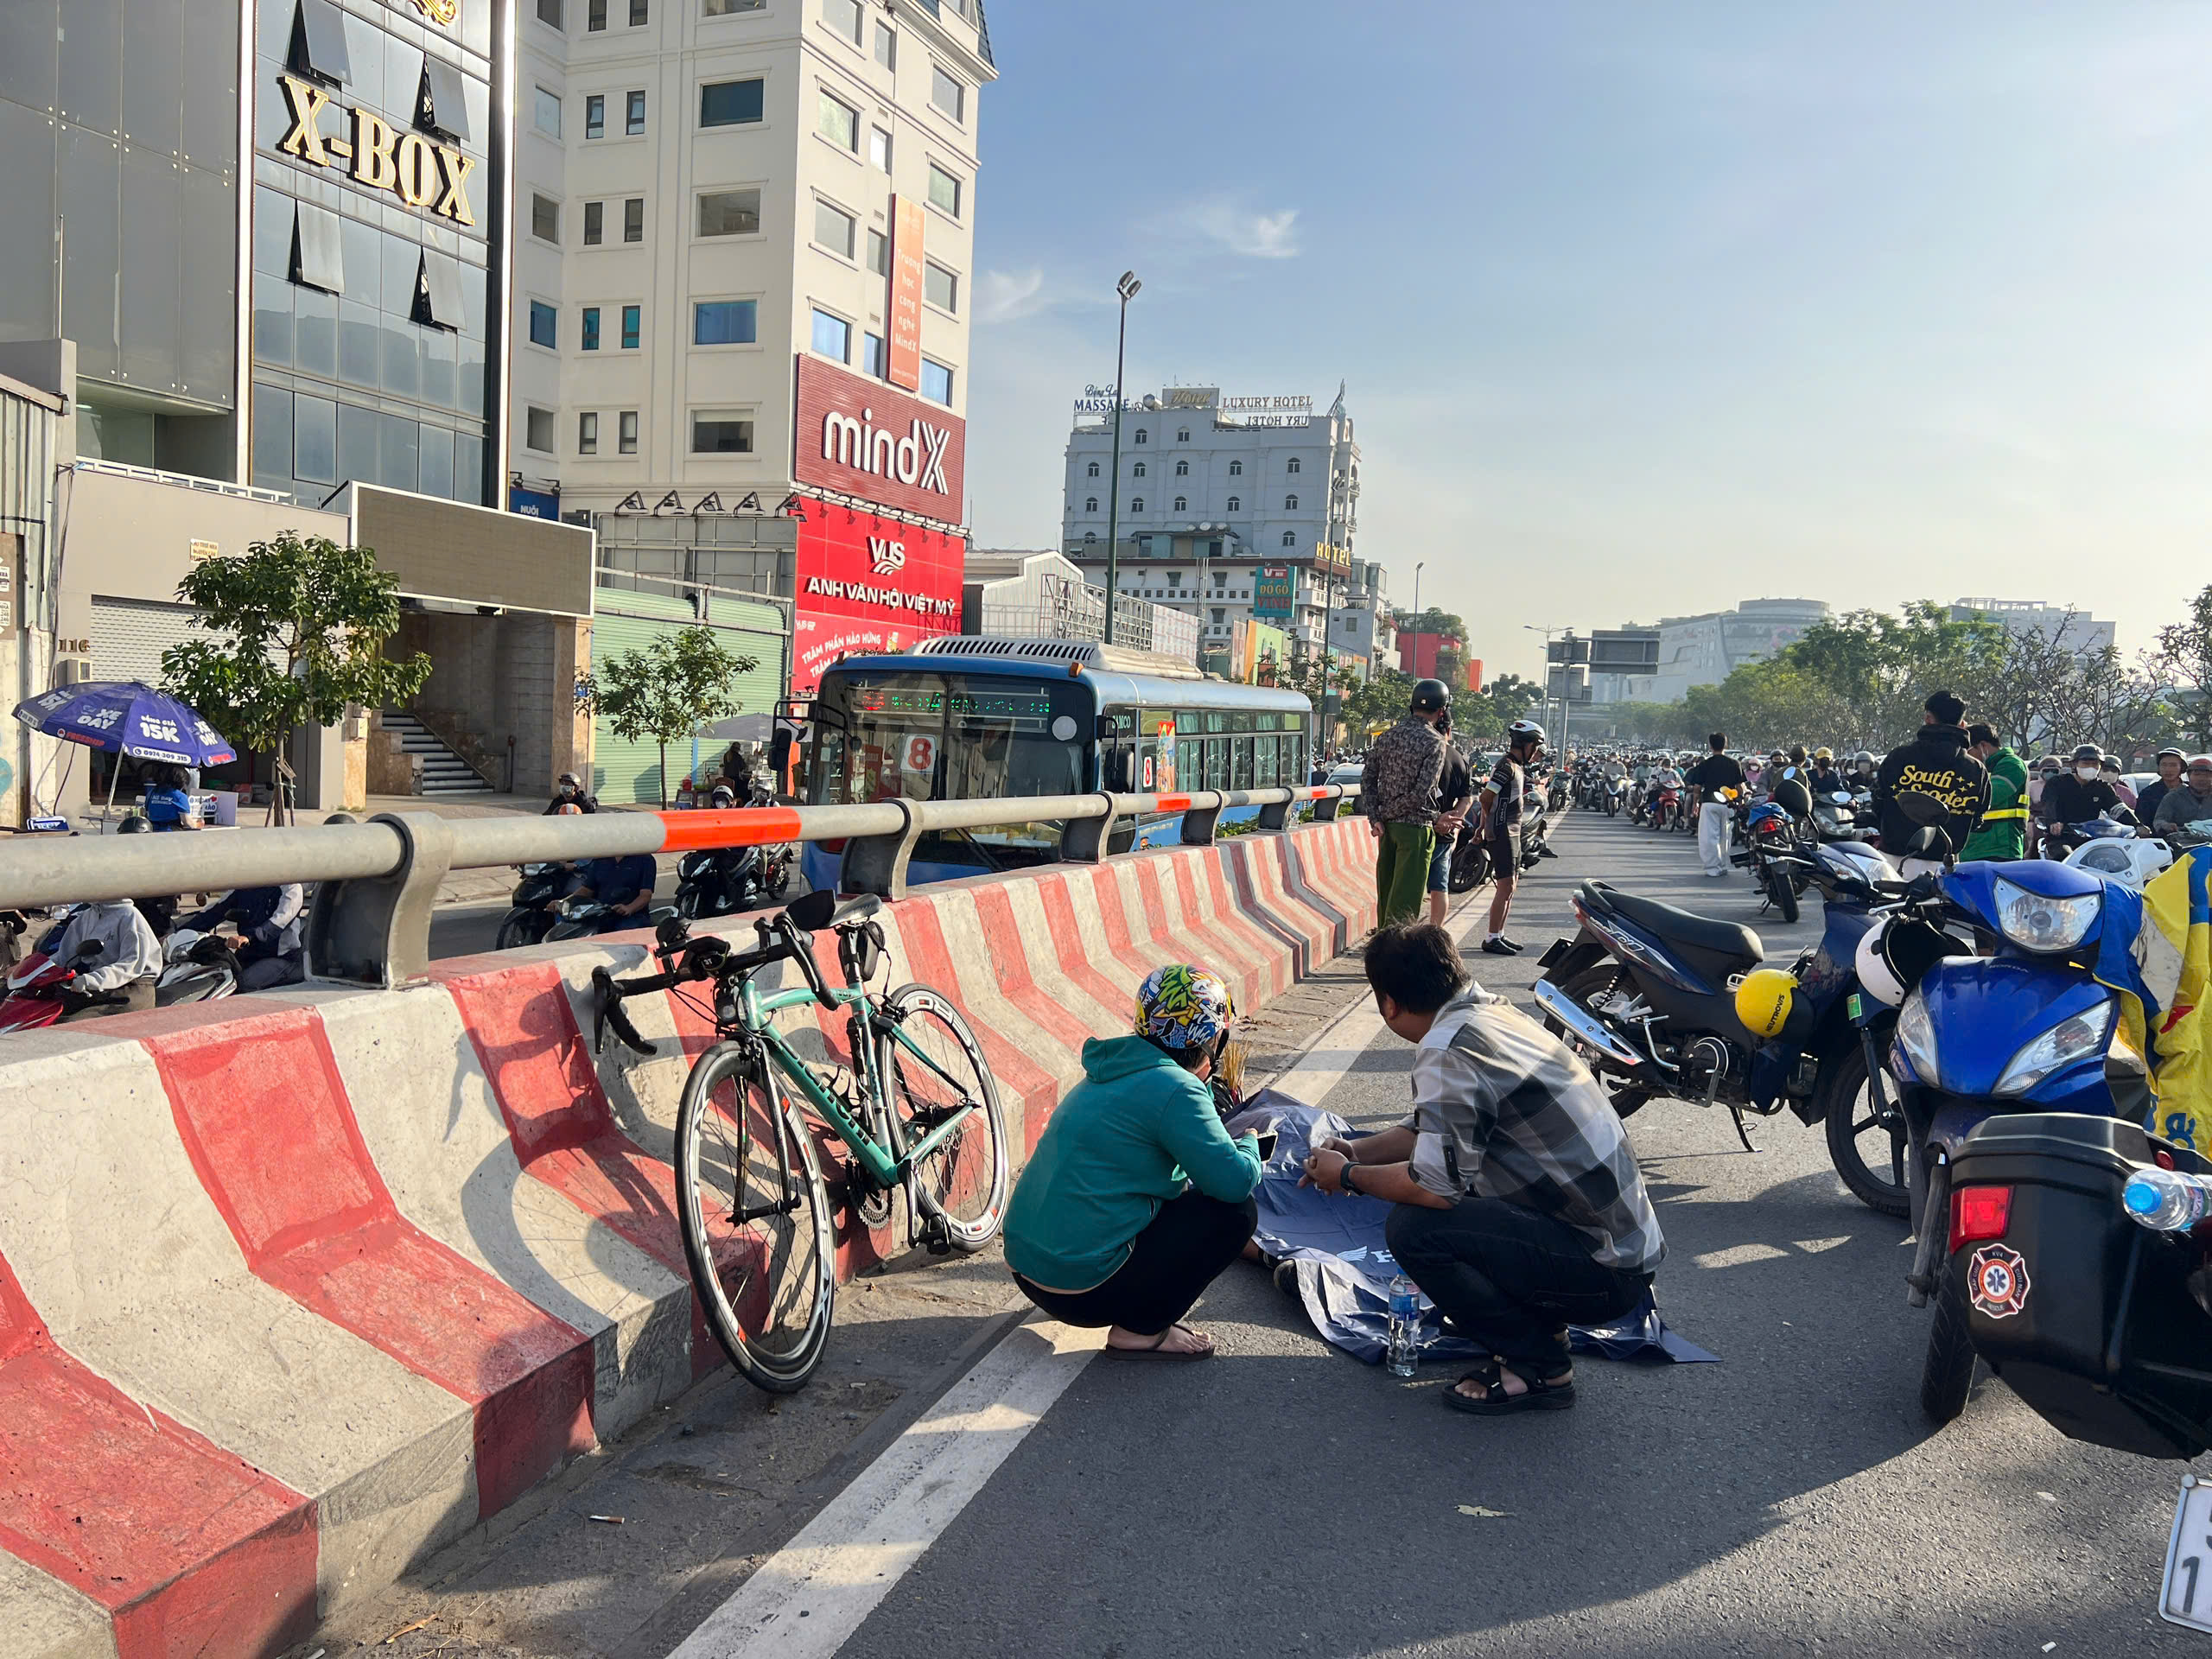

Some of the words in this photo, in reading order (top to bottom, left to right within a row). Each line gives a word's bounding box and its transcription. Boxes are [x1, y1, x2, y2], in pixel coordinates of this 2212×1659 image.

[280, 76, 475, 226] X-BOX
[895, 333, 917, 353] MindX
[1074, 398, 1129, 412] MASSAE
[1223, 397, 1270, 409] LUXURY
[1273, 395, 1313, 408] HOTEL
[823, 408, 950, 495] mindX
[867, 536, 906, 569] VUS
[1316, 541, 1352, 567] HOTEL
[806, 576, 843, 598] ANH
[845, 582, 879, 604] VĂN
[879, 587, 904, 609] HỘI
[905, 592, 935, 614] VIỆT
[1258, 596, 1292, 609] VINH
[96, 709, 123, 721] XE
[139, 721, 181, 743] 15K
[908, 737, 931, 771] 8
[1145, 759, 1151, 785] 8
[1899, 765, 1955, 789] South
[1765, 994, 1786, 1033] NEUTROVIS
